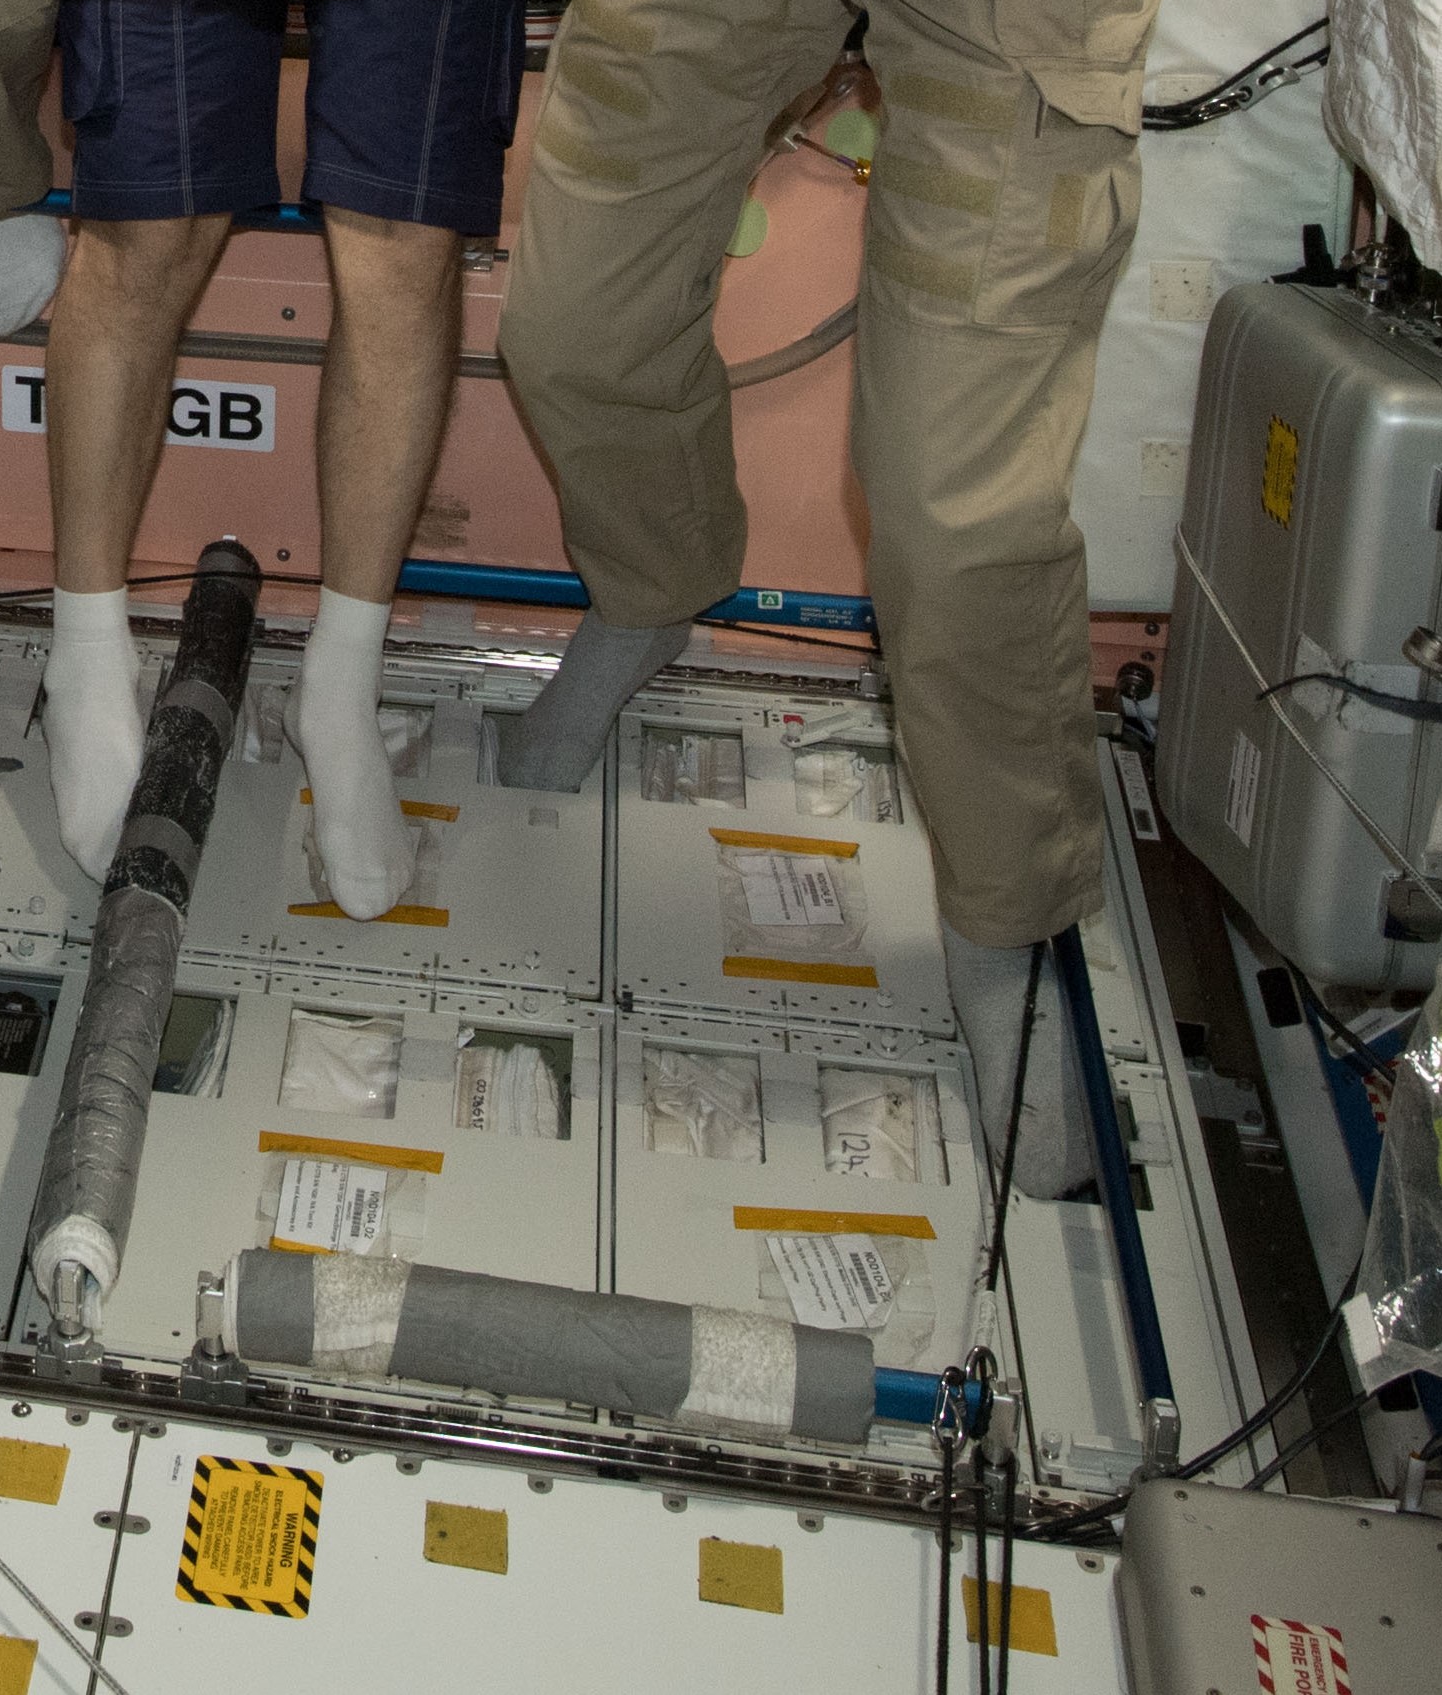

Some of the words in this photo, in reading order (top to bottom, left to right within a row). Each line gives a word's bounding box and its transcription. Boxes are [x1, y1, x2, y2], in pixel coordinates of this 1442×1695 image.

[219, 1491, 227, 1500] TO
[228, 1486, 238, 1513] REMOVE
[251, 1480, 260, 1502] SMOKE
[206, 1497, 218, 1532] ATTACHED
[216, 1501, 225, 1533] PREVENT
[239, 1492, 250, 1526] REMOVING
[257, 1488, 269, 1527] DEACTIVATE
[271, 1490, 282, 1530] ELECTRICAL
[224, 1516, 234, 1537] PANEL
[247, 1504, 257, 1541] DETECTOR
[204, 1534, 212, 1559] WIRING
[211, 1534, 221, 1570] DAMAGING
[236, 1527, 245, 1554] ACCESS
[244, 1542, 253, 1561] (ASD)
[254, 1529, 265, 1553] POWER
[268, 1533, 277, 1556] SHOCK
[220, 1538, 230, 1577] CAREFULLY
[233, 1555, 241, 1577] PANEL
[254, 1555, 261, 1565] TO
[240, 1562, 250, 1591] BEFORE
[251, 1566, 260, 1585] AREA
[265, 1557, 273, 1587] HAZARD
[1288, 1633, 1308, 1667] FIRE
[1309, 1637, 1327, 1693] EMERGENCY
